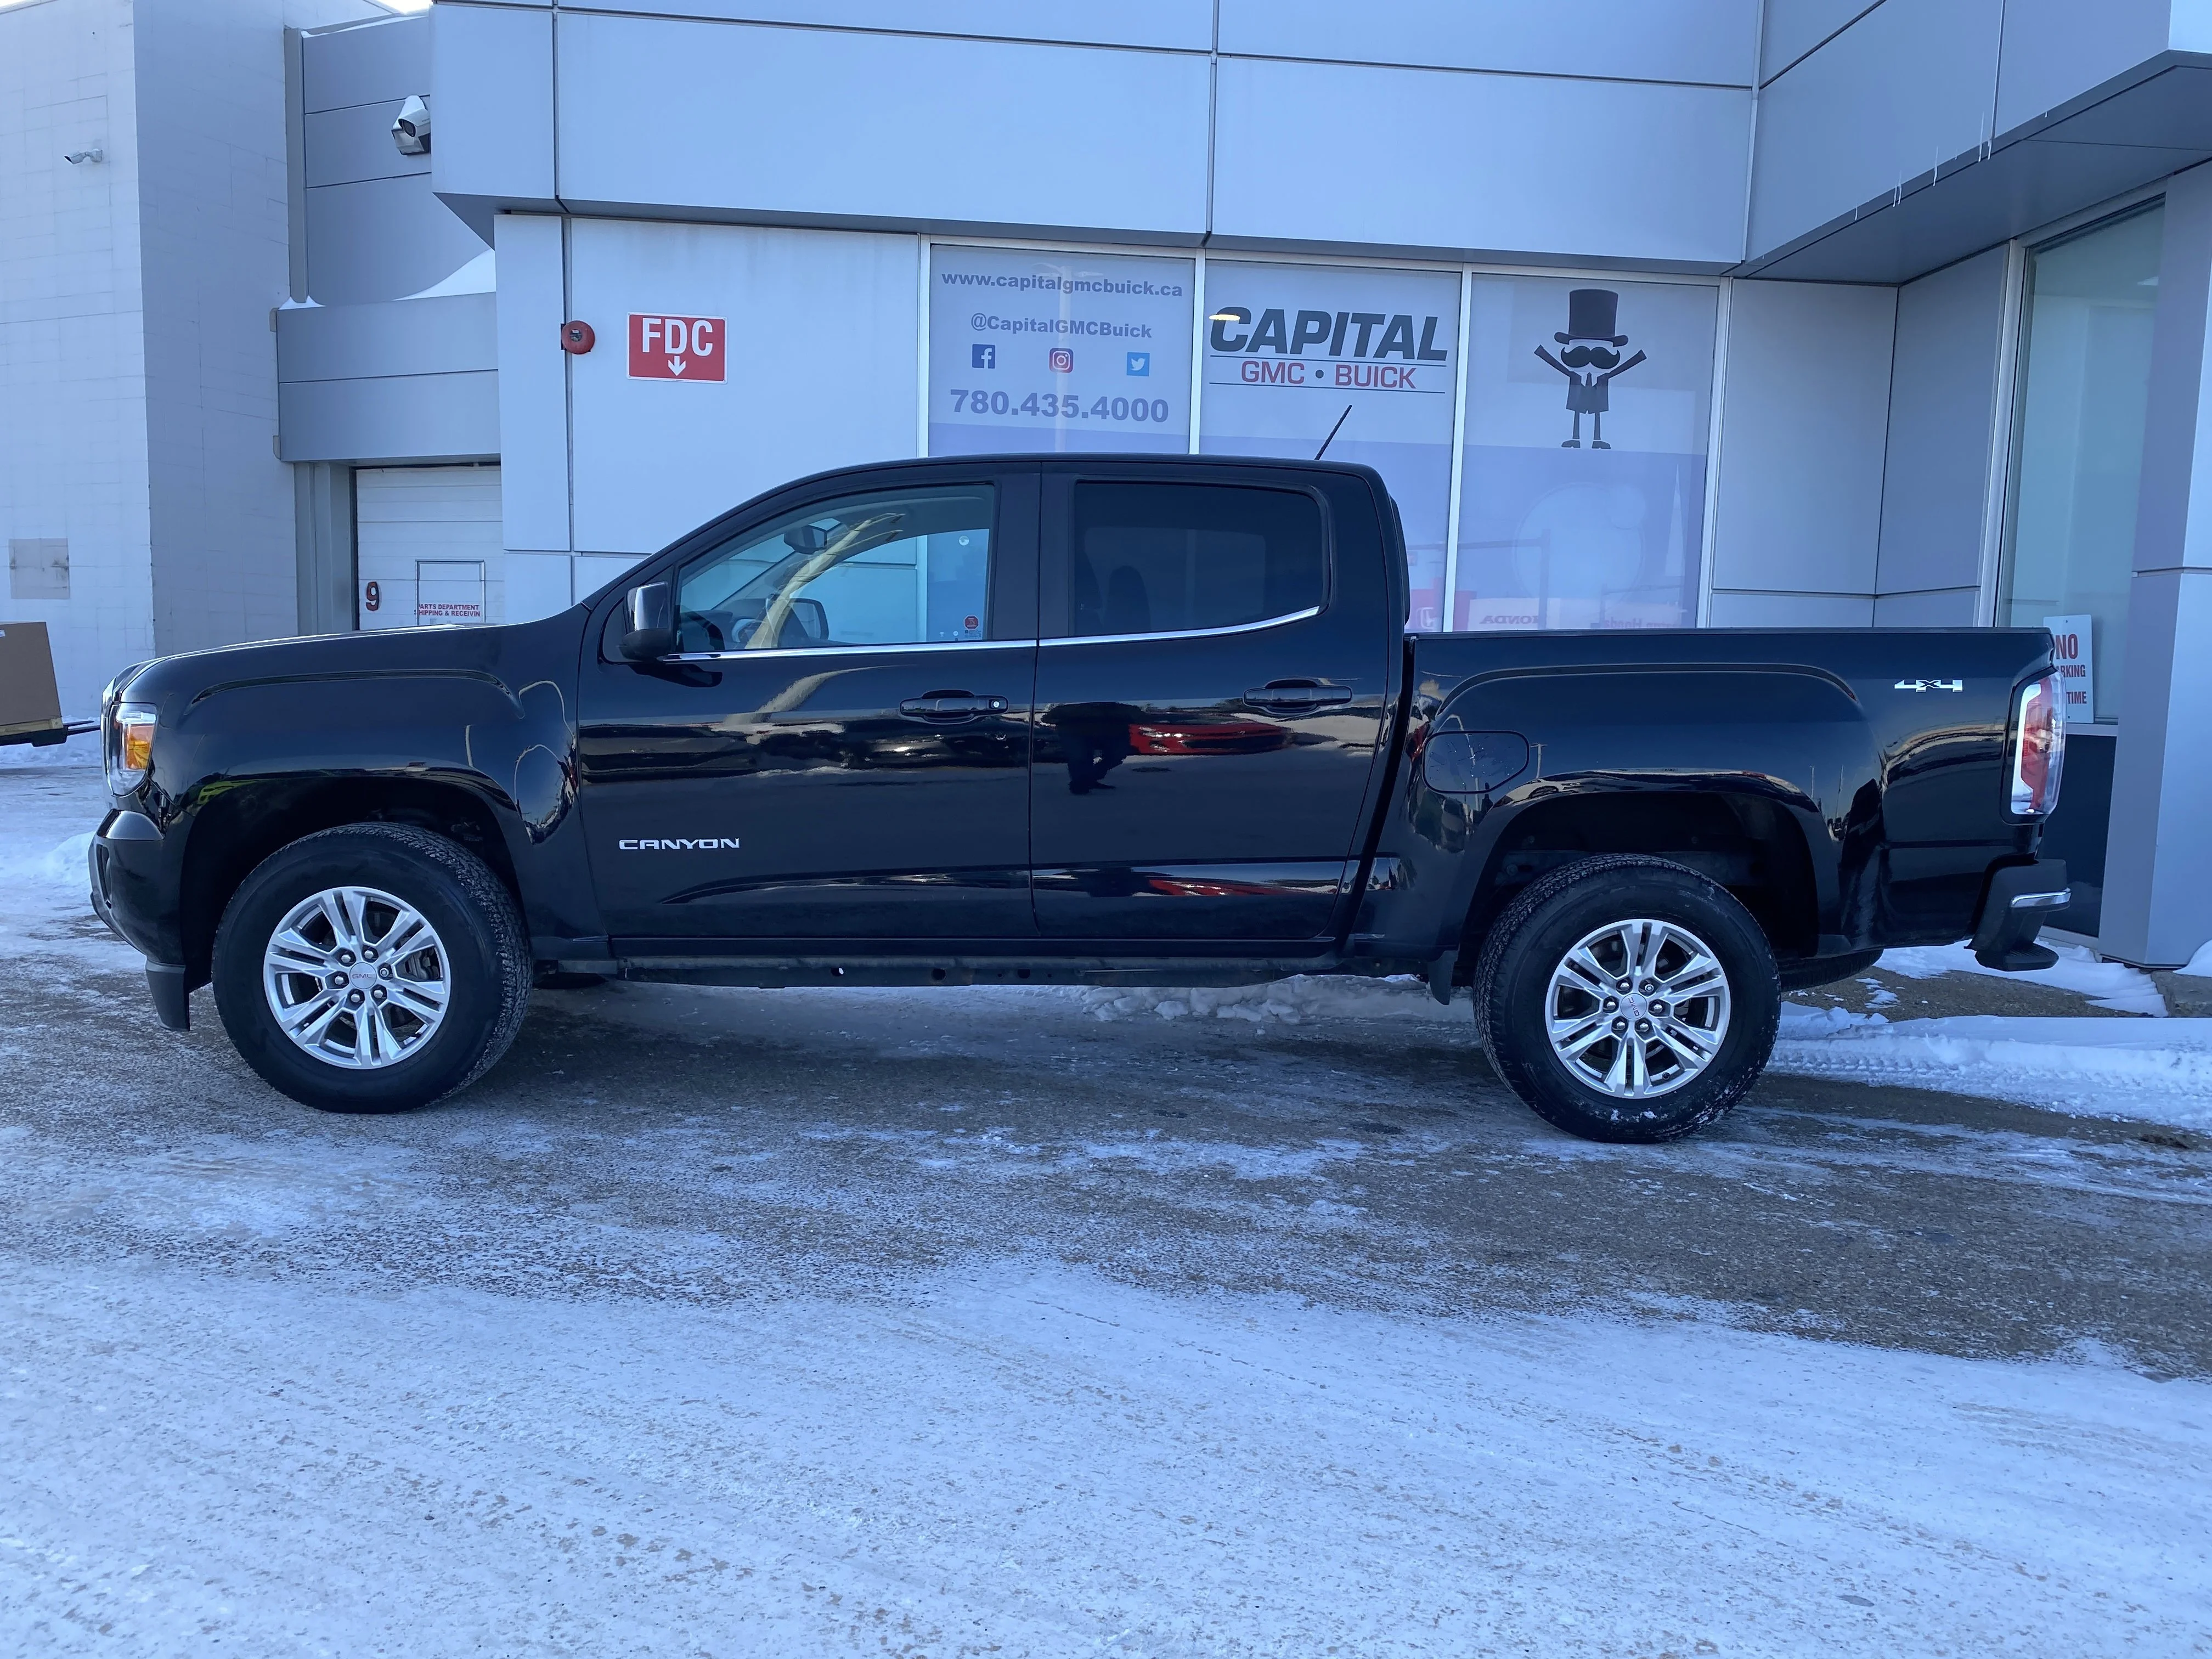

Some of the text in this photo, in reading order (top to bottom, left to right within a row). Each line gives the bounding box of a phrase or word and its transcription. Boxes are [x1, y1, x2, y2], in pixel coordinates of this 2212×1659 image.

[941, 273, 1183, 297] www.capitalgmcbuick.ca
[642, 317, 713, 357] FDC
[970, 313, 1153, 338] @CapitalGMCBuick
[1209, 306, 1448, 362] CAPITAL
[1241, 360, 1417, 389] GMC BUICK
[950, 389, 1169, 423] 780.435.4000
[365, 581, 380, 612] 9
[2055, 634, 2078, 659] NO
[2056, 664, 2086, 678] RKING
[2066, 691, 2087, 704] TIME
[619, 838, 740, 850] CANYON
[1628, 996, 1640, 1017] GMC
